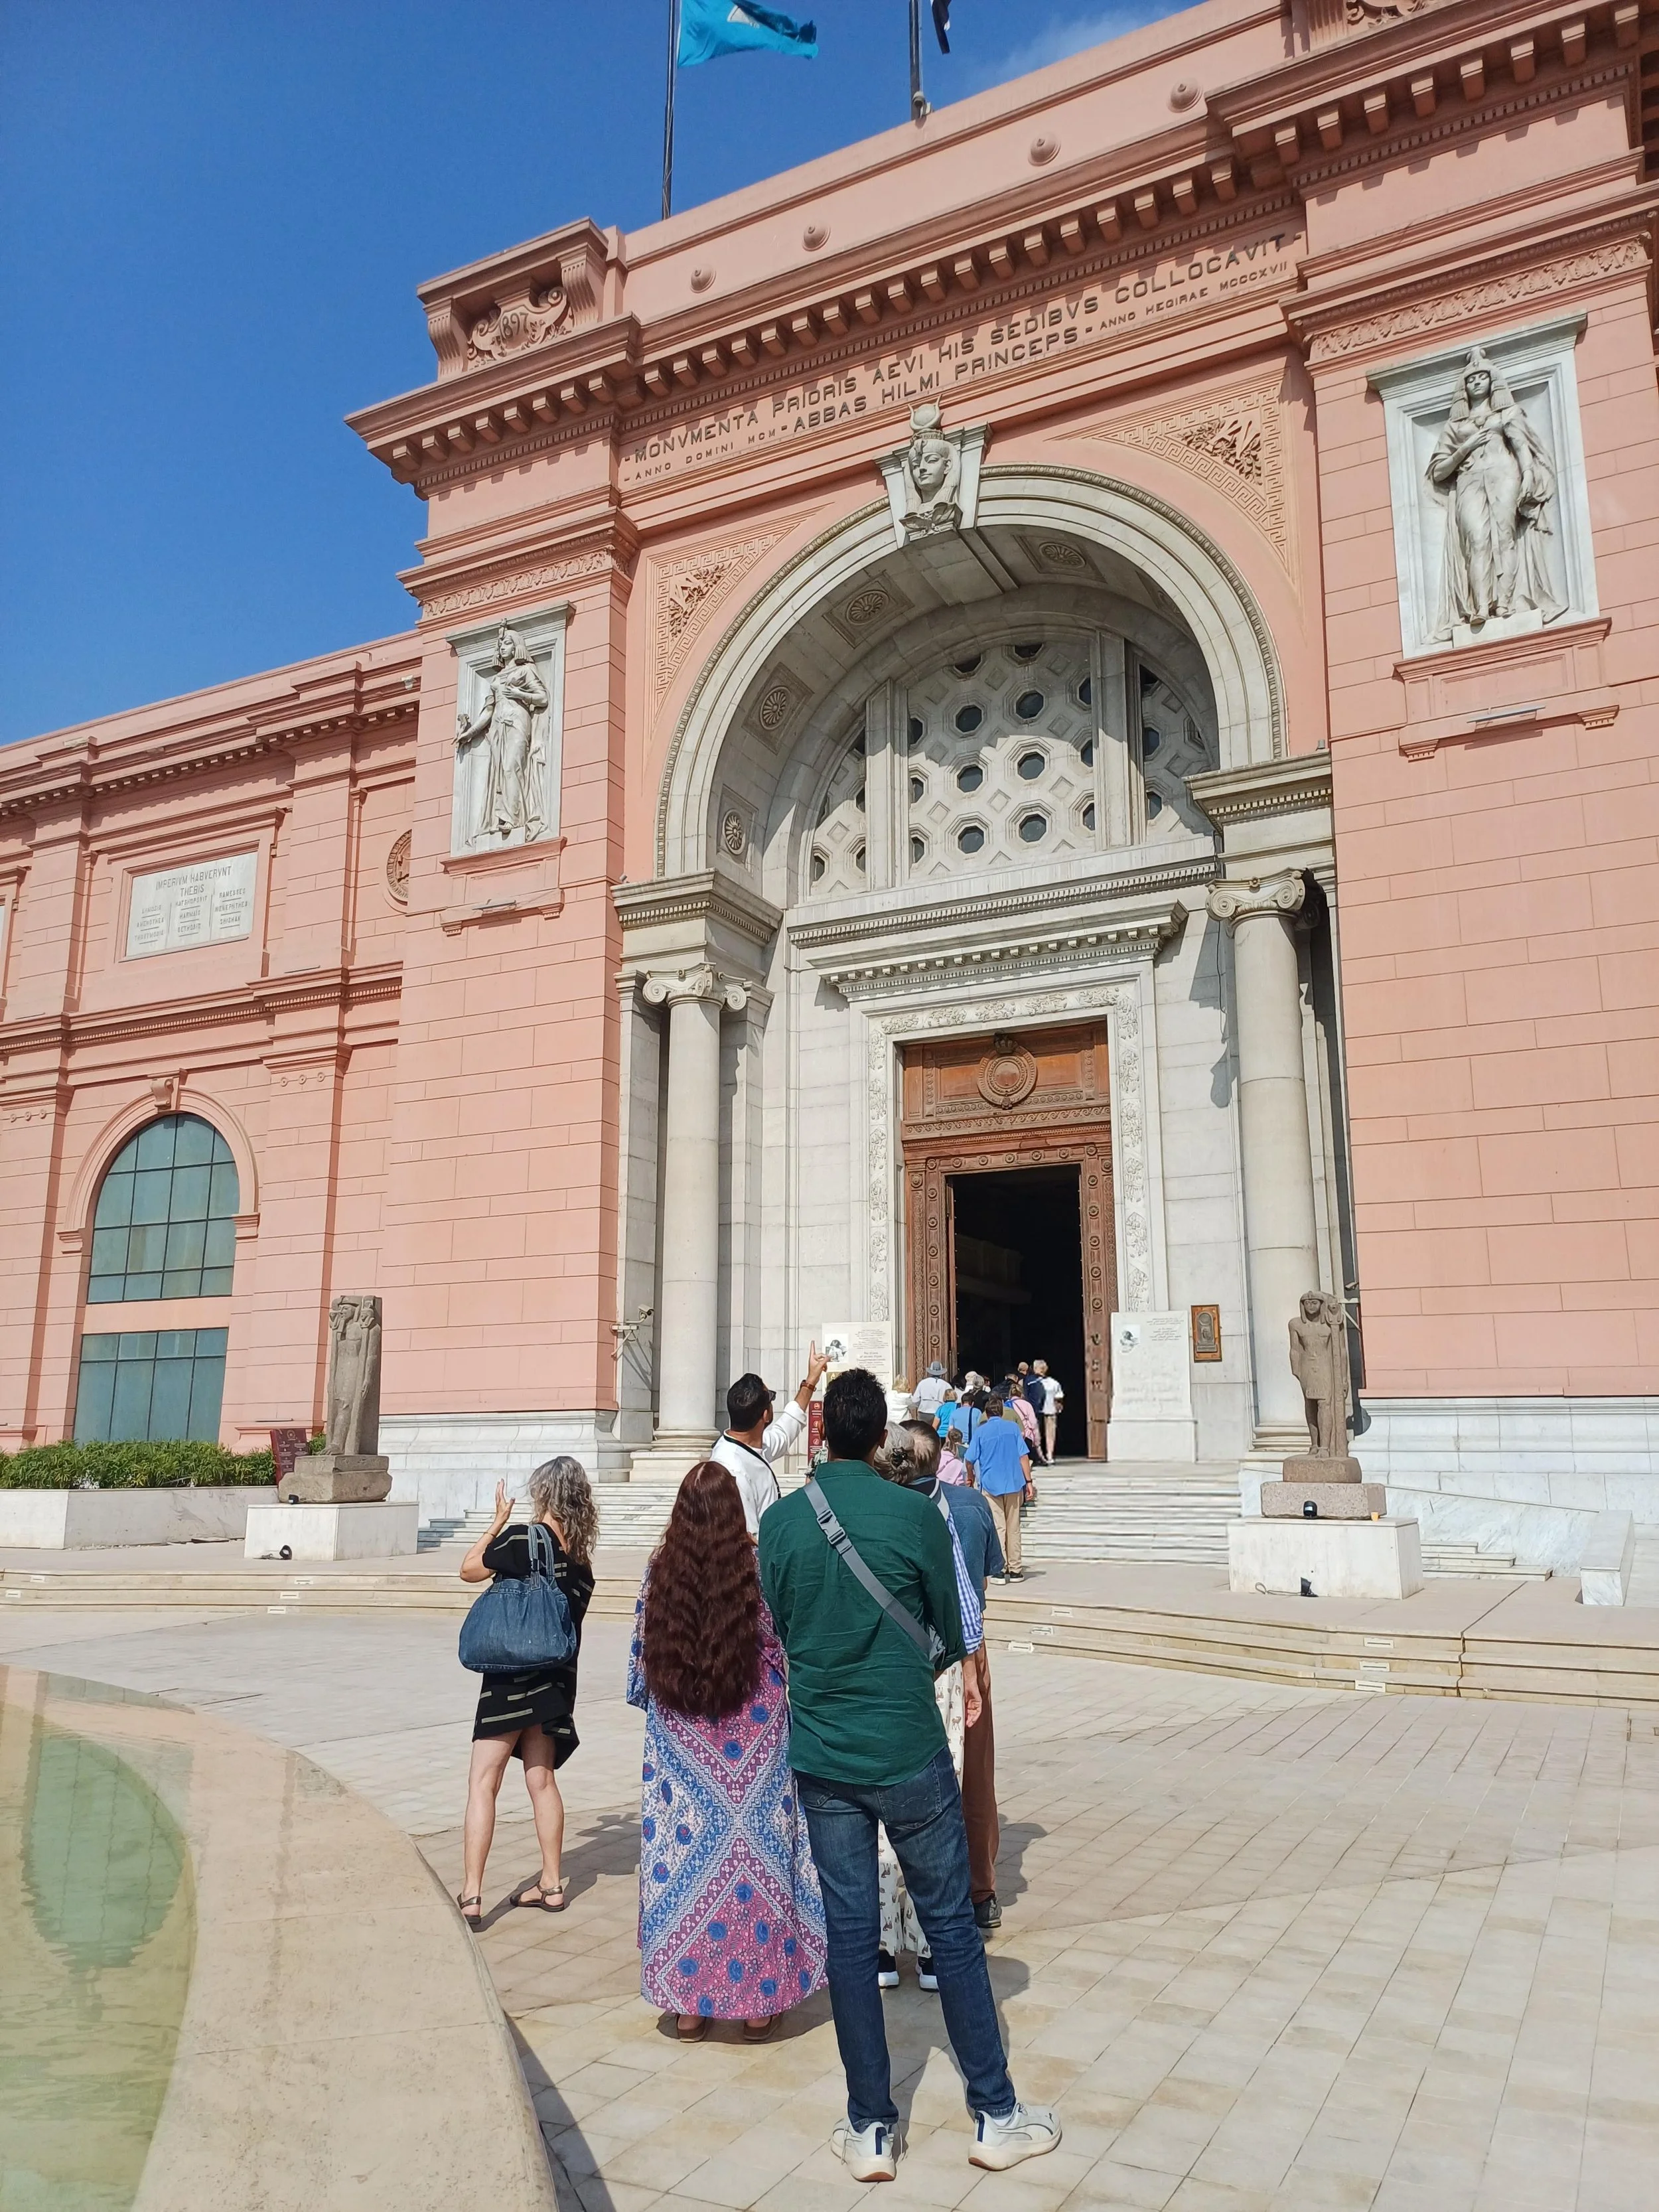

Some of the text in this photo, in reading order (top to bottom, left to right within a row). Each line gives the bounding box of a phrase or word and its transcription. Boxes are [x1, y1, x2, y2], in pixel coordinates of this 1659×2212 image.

[635, 234, 1285, 463] MONVMENTA PRIORIS AEVI HIS SEDIBVS COLLOCAVIT
[635, 261, 1287, 480] ANNO DOMINI MCM ABBAS HILMI PRINCEPS ANNO HEGIRAE MCCCXVII
[155, 865, 232, 890] IMPERIVM HABVERVNT
[180, 884, 204, 897] THEBIS
